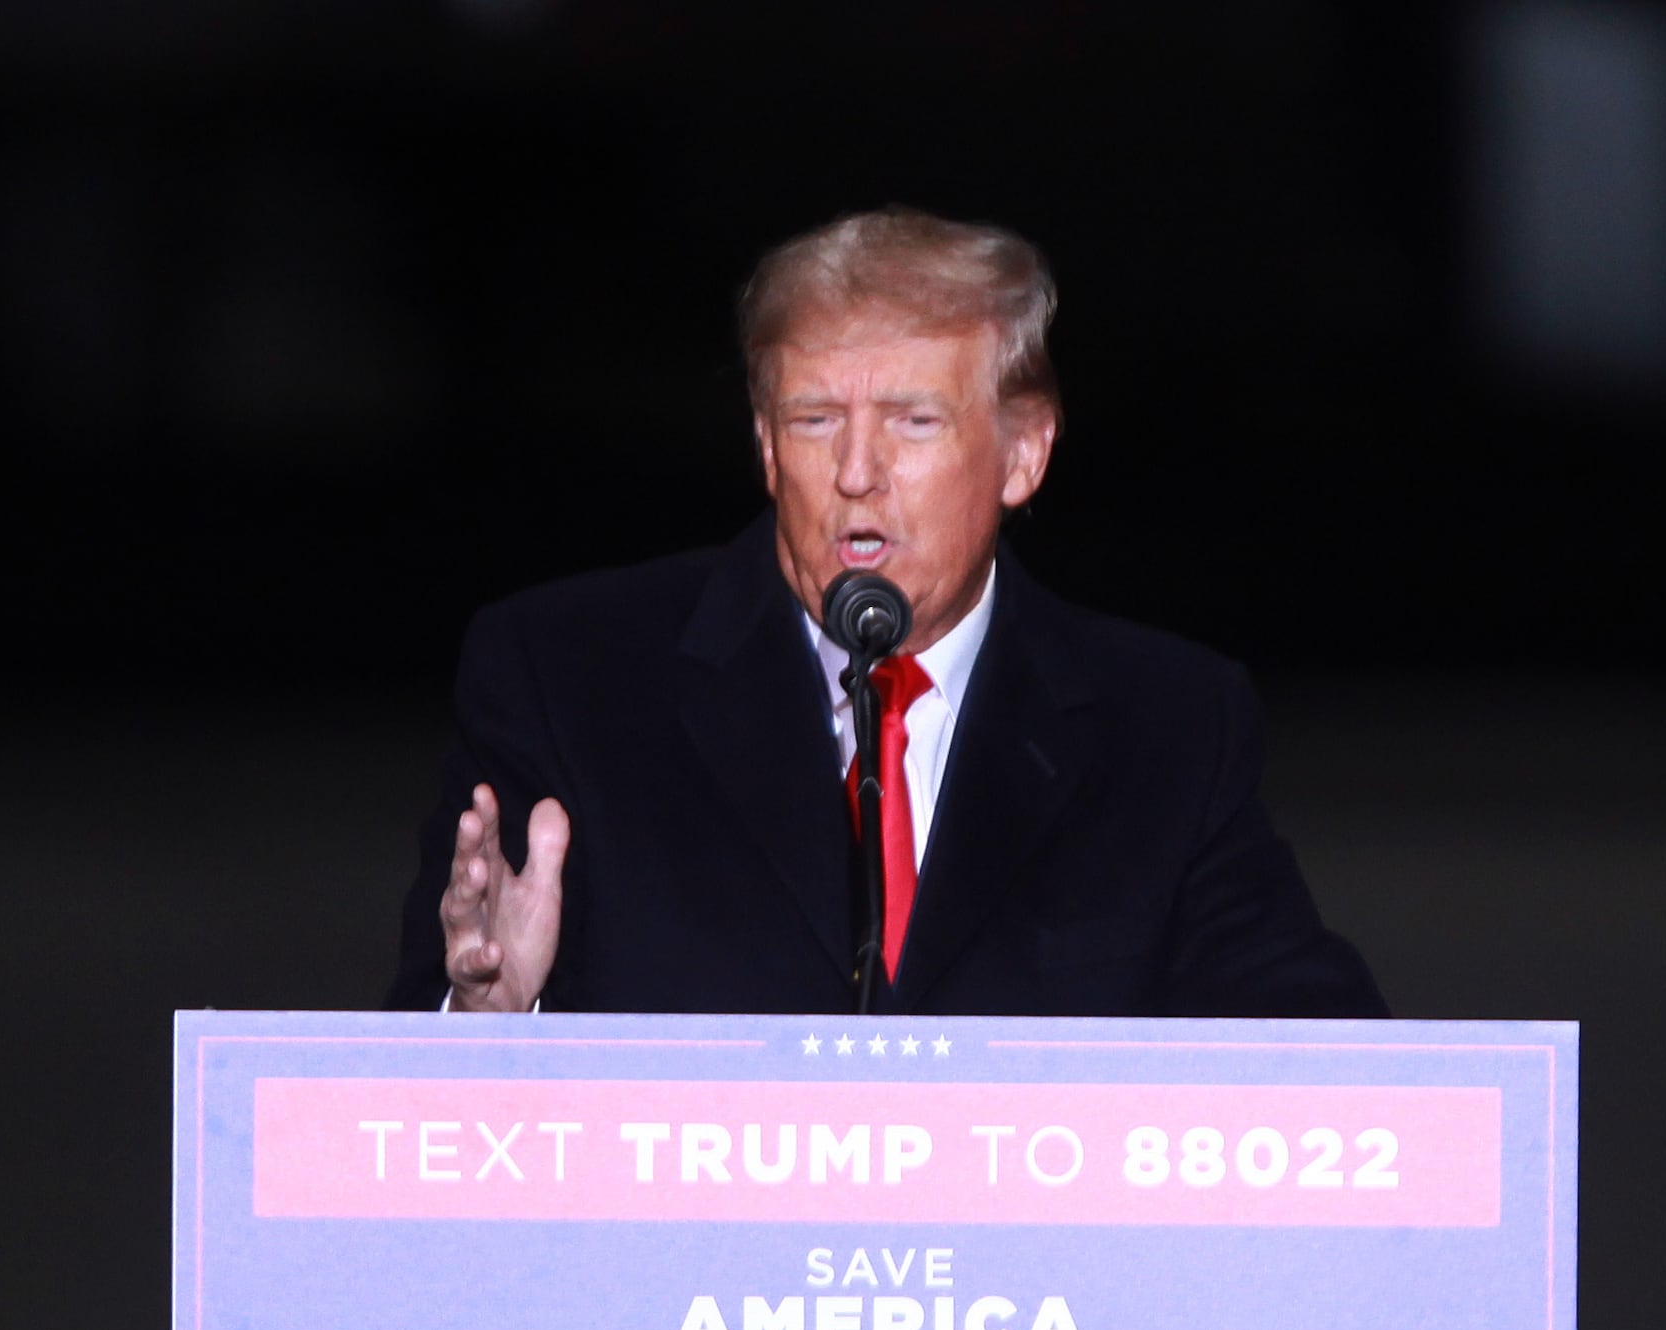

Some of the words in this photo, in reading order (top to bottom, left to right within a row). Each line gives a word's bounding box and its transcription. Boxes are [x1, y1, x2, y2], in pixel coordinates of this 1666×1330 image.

[357, 1119, 584, 1182] TEXT
[619, 1122, 935, 1186] TRUMP
[968, 1125, 1087, 1186] TO
[1117, 1126, 1404, 1190] 88022
[806, 1247, 955, 1287] SAVE
